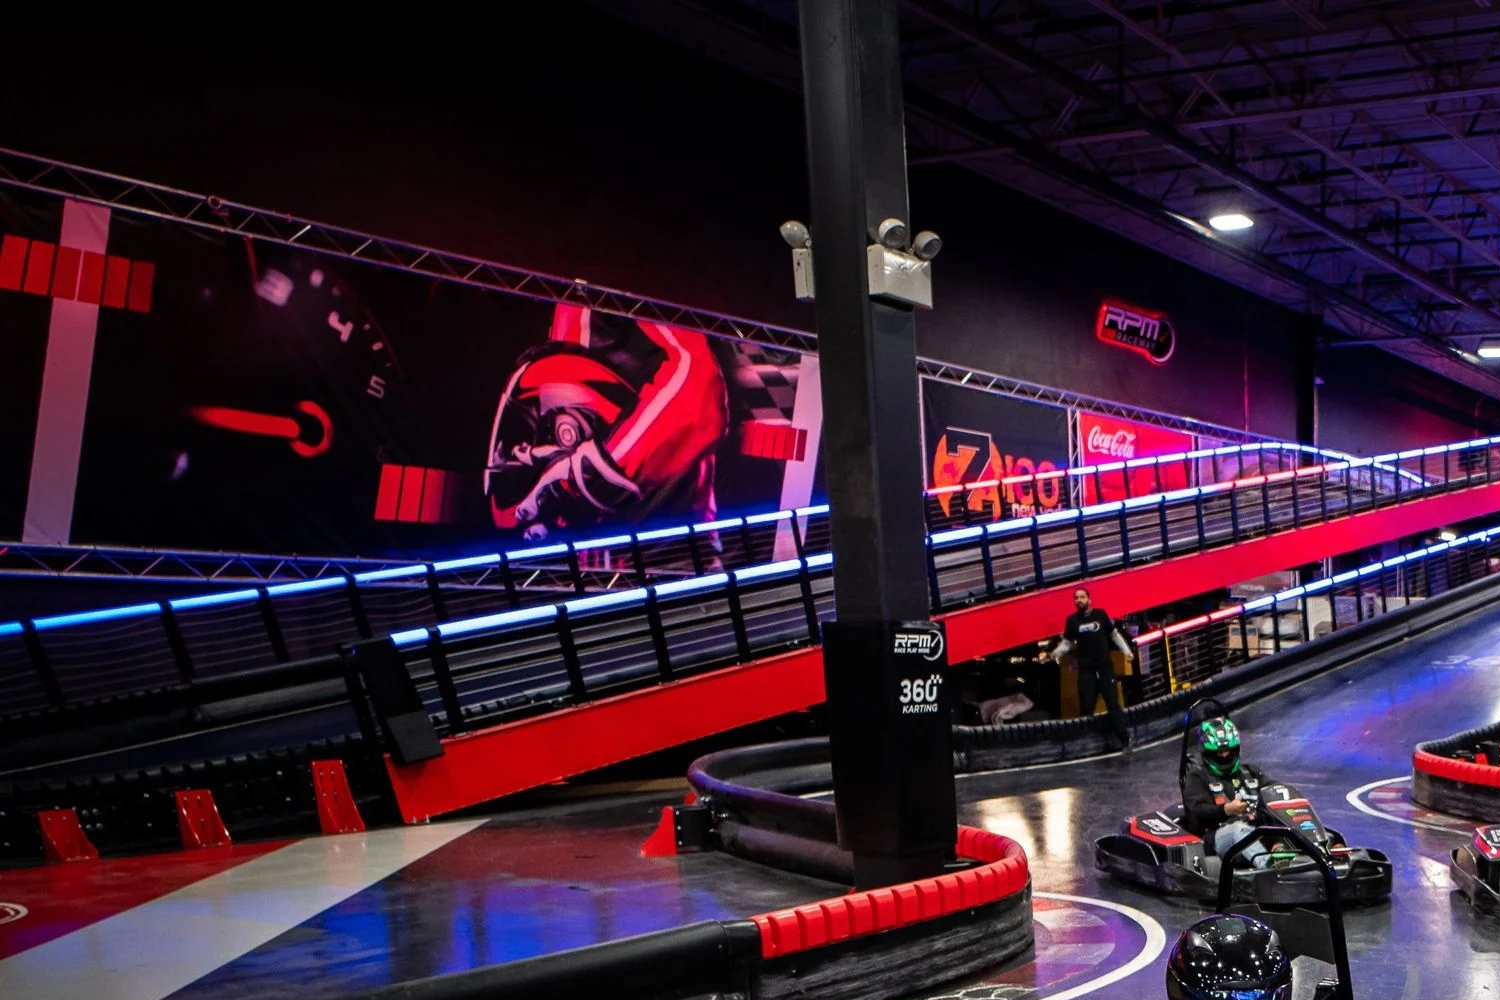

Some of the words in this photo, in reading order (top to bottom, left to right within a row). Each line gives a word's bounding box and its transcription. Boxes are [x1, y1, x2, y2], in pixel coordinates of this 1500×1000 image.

[1104, 305, 1160, 340] RPM
[1116, 331, 1157, 350] RACEWAY
[367, 374, 386, 399] 5
[894, 633, 932, 648] RPM
[899, 678, 938, 703] 360
[902, 703, 938, 715] KARTING
